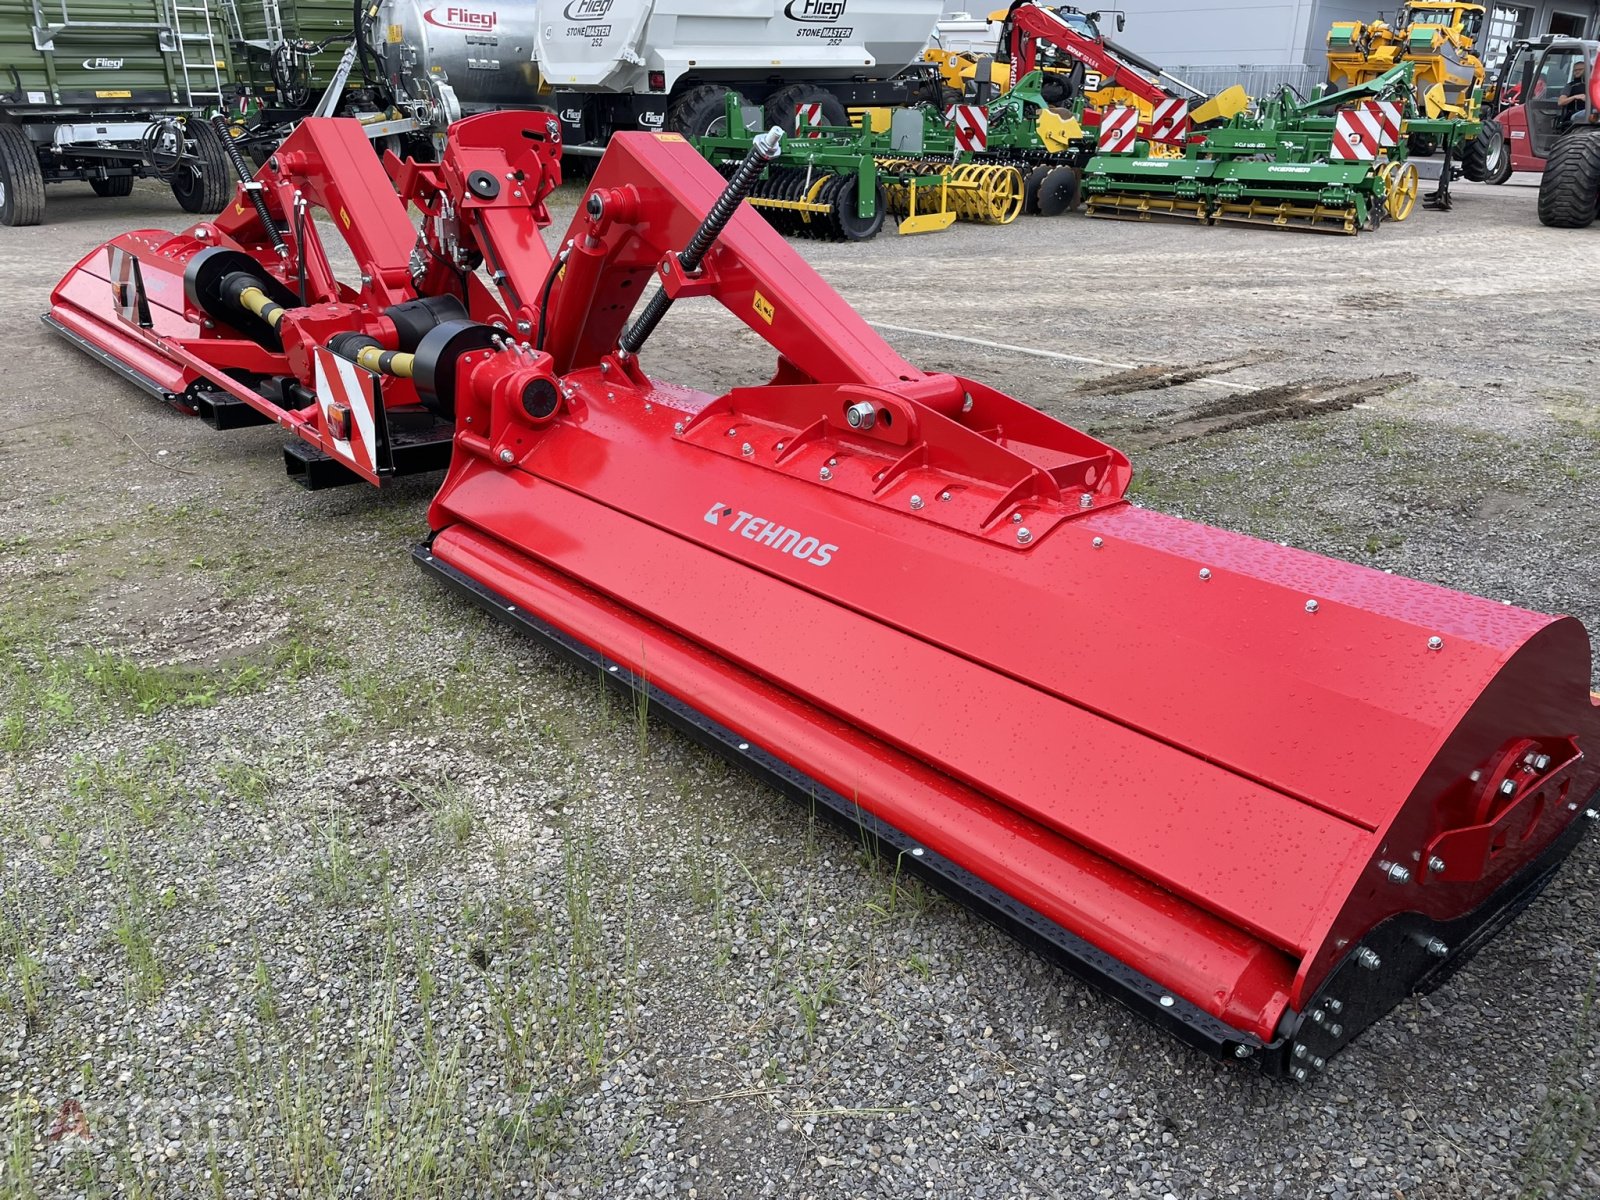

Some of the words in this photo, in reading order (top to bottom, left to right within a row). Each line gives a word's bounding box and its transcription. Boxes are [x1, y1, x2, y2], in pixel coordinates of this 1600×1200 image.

[803, 0, 847, 19] Fliegl
[447, 8, 497, 28] Fliegl
[592, 38, 603, 47] 252
[95, 57, 124, 69] Fliegl
[566, 108, 582, 121] Fliegl
[645, 111, 665, 125] Fliegl
[728, 510, 840, 567] TEHNOS
